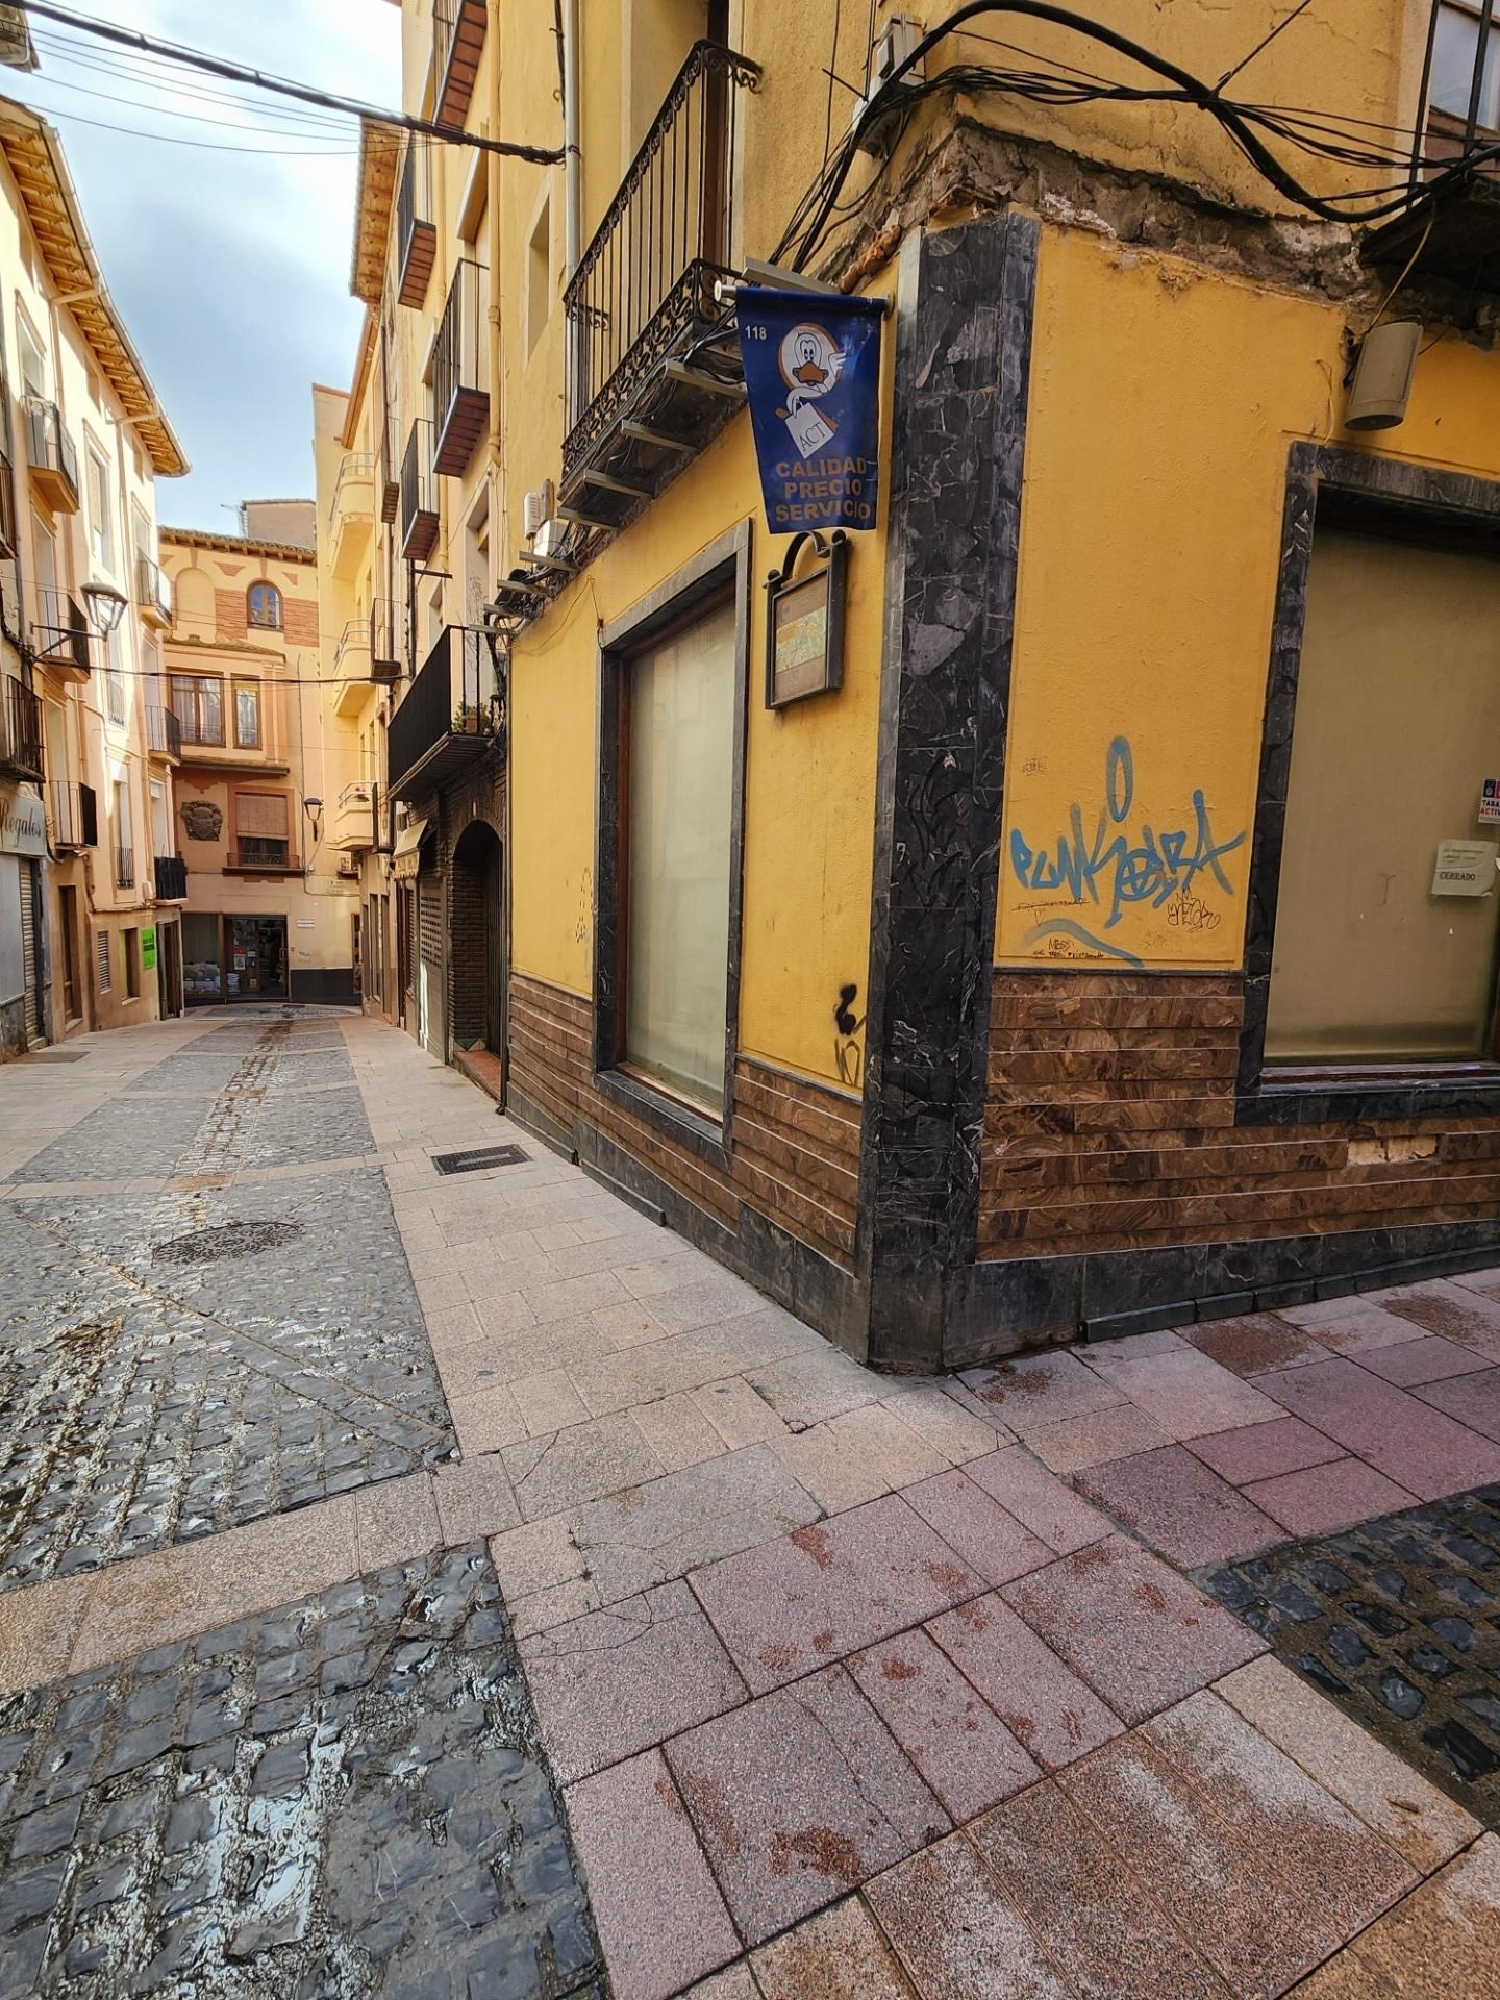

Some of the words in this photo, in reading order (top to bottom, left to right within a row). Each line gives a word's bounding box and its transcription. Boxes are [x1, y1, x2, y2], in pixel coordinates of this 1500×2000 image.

[745, 325, 767, 341] 118
[798, 421, 829, 453] ACT
[776, 457, 867, 477] CALIDAD
[783, 479, 861, 499] PRECIO
[775, 500, 871, 523] SERVICIO
